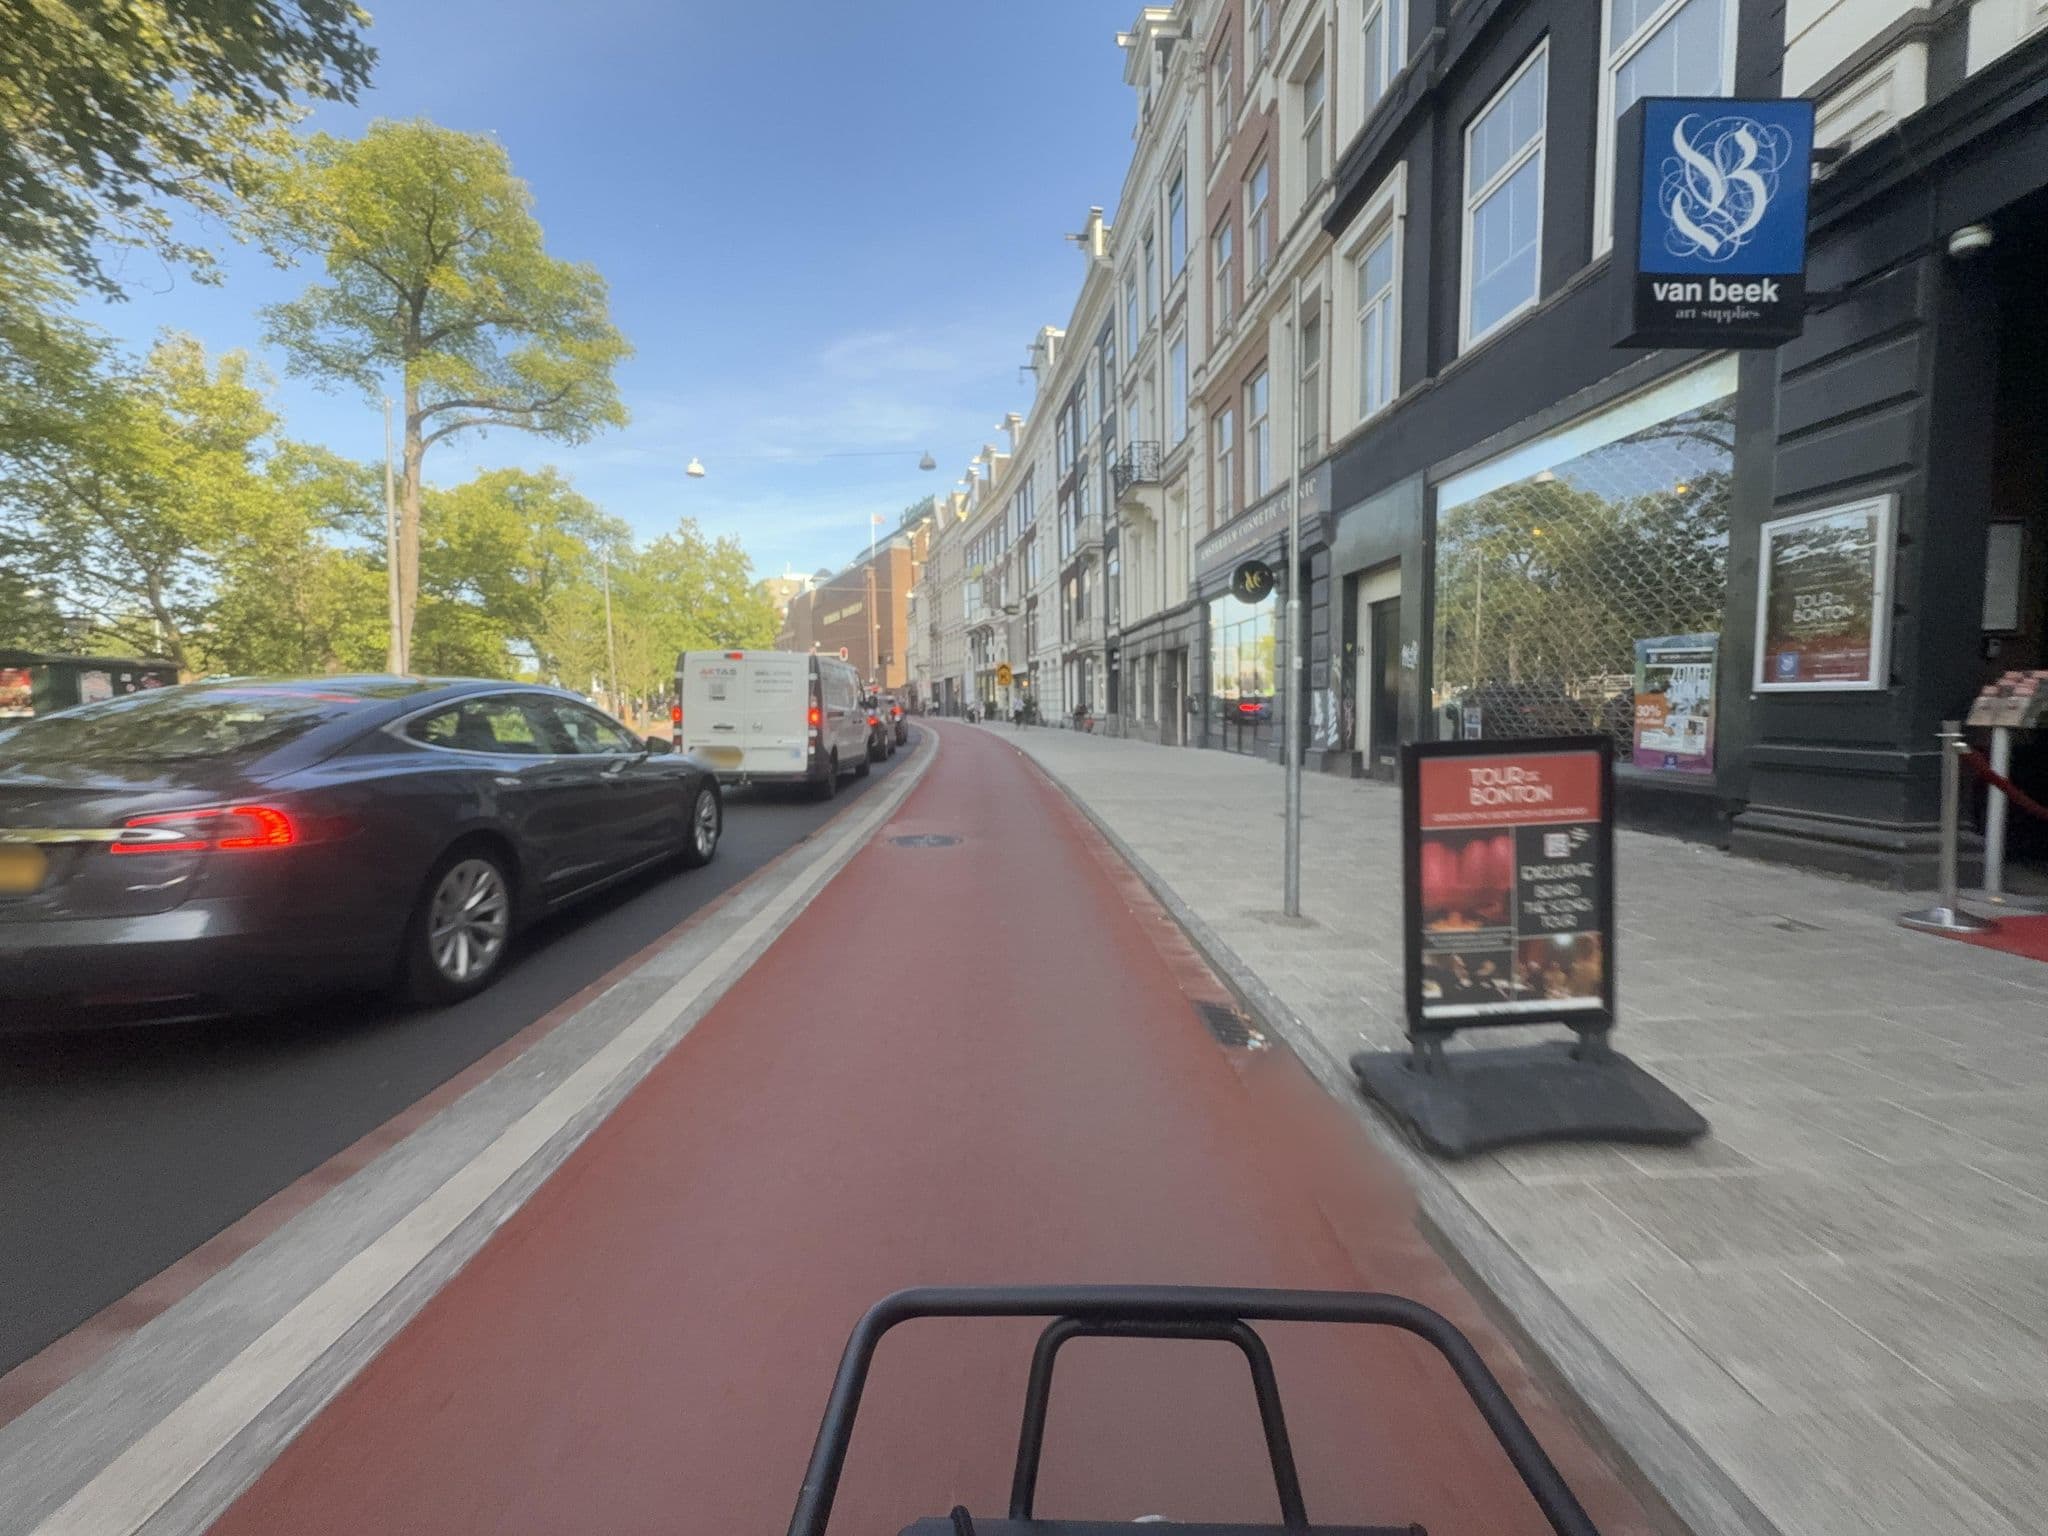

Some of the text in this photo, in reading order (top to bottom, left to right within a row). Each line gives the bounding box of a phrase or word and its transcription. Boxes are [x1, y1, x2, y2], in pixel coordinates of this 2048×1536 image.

[1653, 277, 1780, 302] van beek
[1675, 305, 1760, 324] art supplies
[1794, 592, 1833, 608] TOUR
[1792, 604, 1854, 623] BONTON
[1468, 766, 1524, 786] TOUR
[1469, 785, 1554, 806] BONTON
